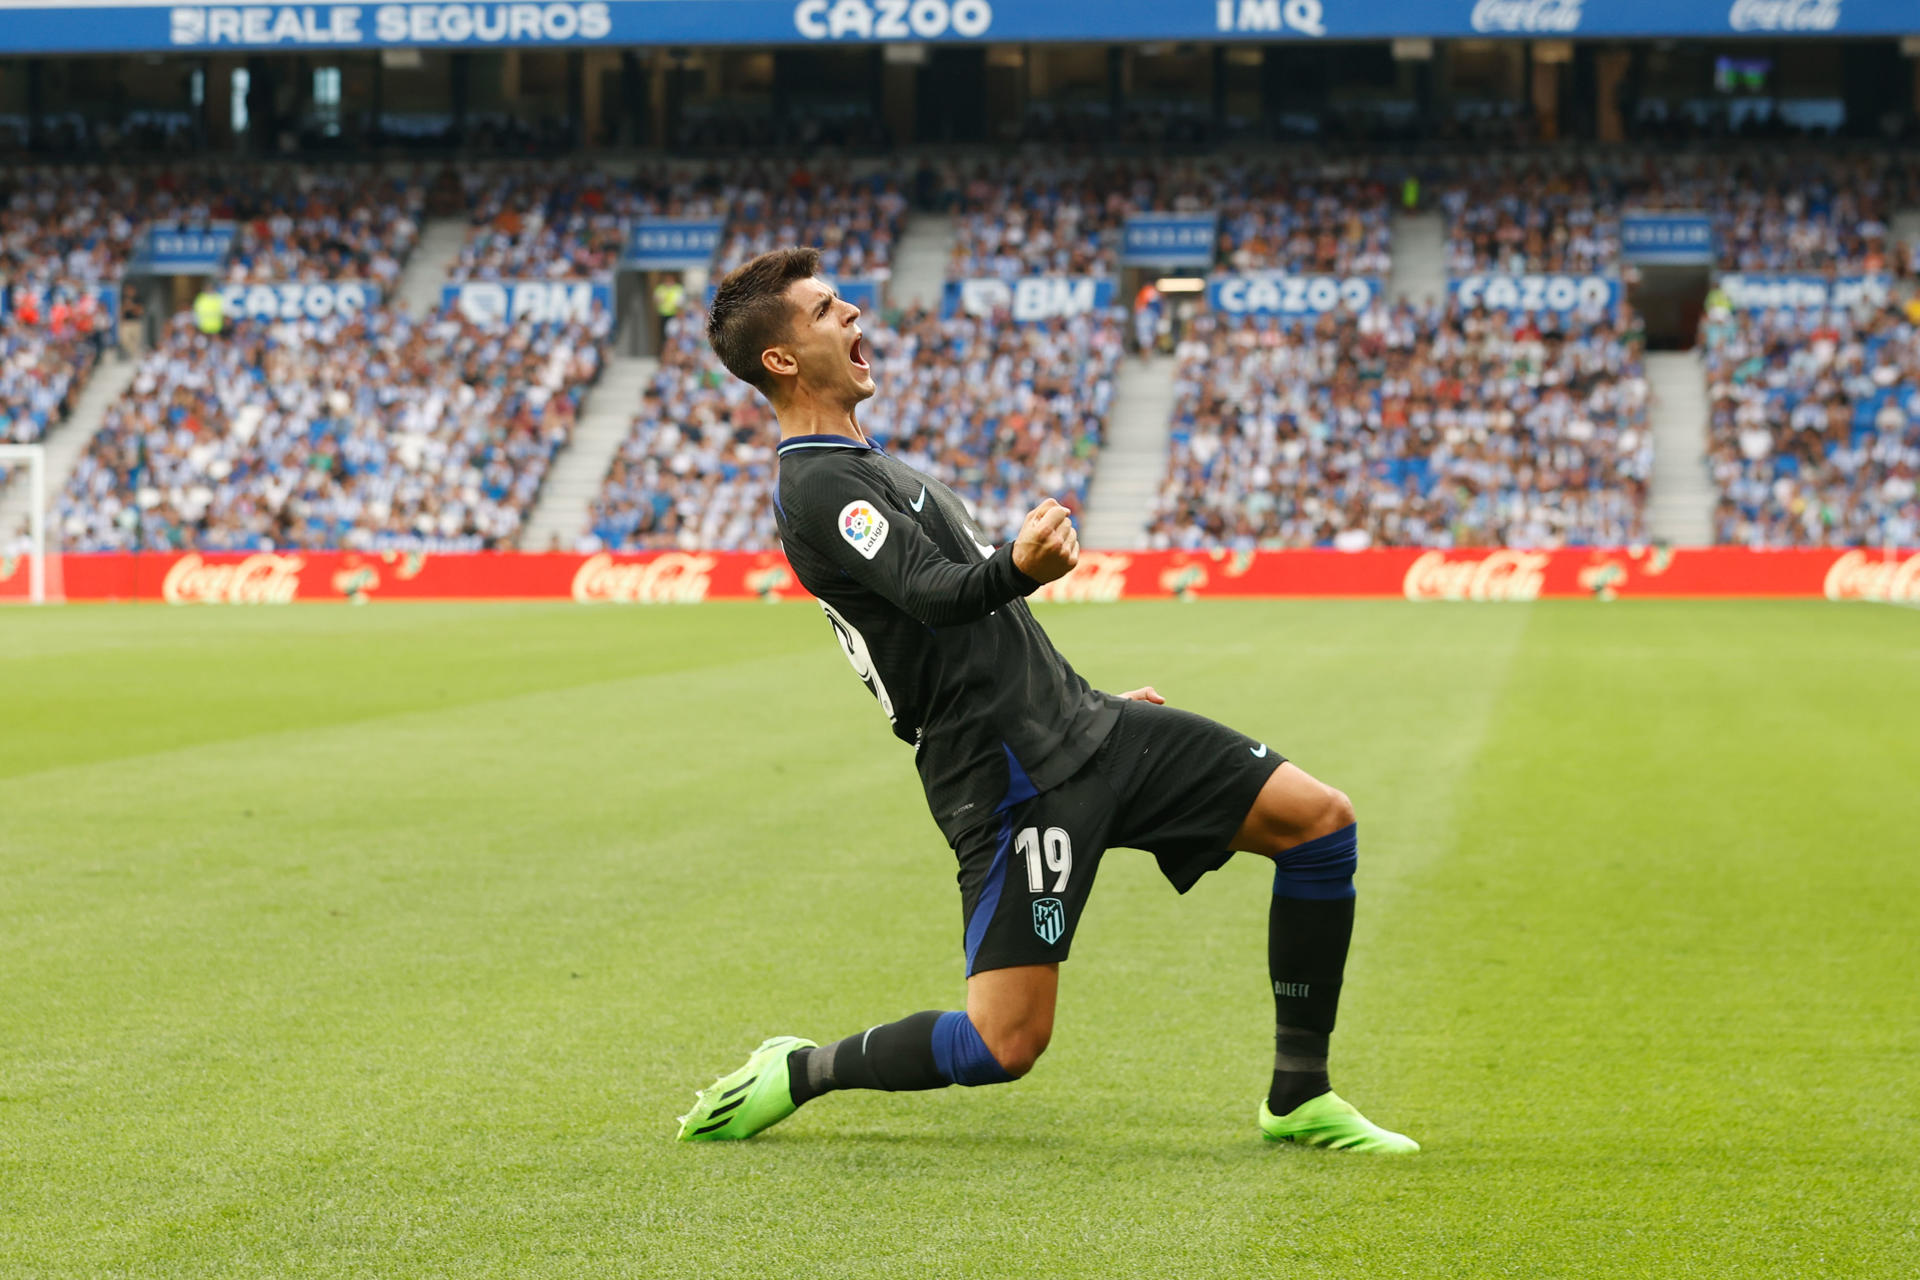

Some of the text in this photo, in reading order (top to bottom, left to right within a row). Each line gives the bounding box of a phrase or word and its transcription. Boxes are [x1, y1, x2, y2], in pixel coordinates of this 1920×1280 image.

[208, 4, 611, 43] REALE SEGUROS
[794, 0, 993, 37] CAZOO
[1216, 0, 1327, 36] IMQ
[222, 284, 366, 320] CAZOO
[1219, 276, 1370, 313] CAZOO
[1458, 275, 1610, 311] CAZOO
[163, 554, 304, 604] Coca-Cola
[571, 551, 717, 604] Coca-Cola
[1404, 550, 1548, 600] Coca-Cola
[1014, 827, 1072, 893] 19
